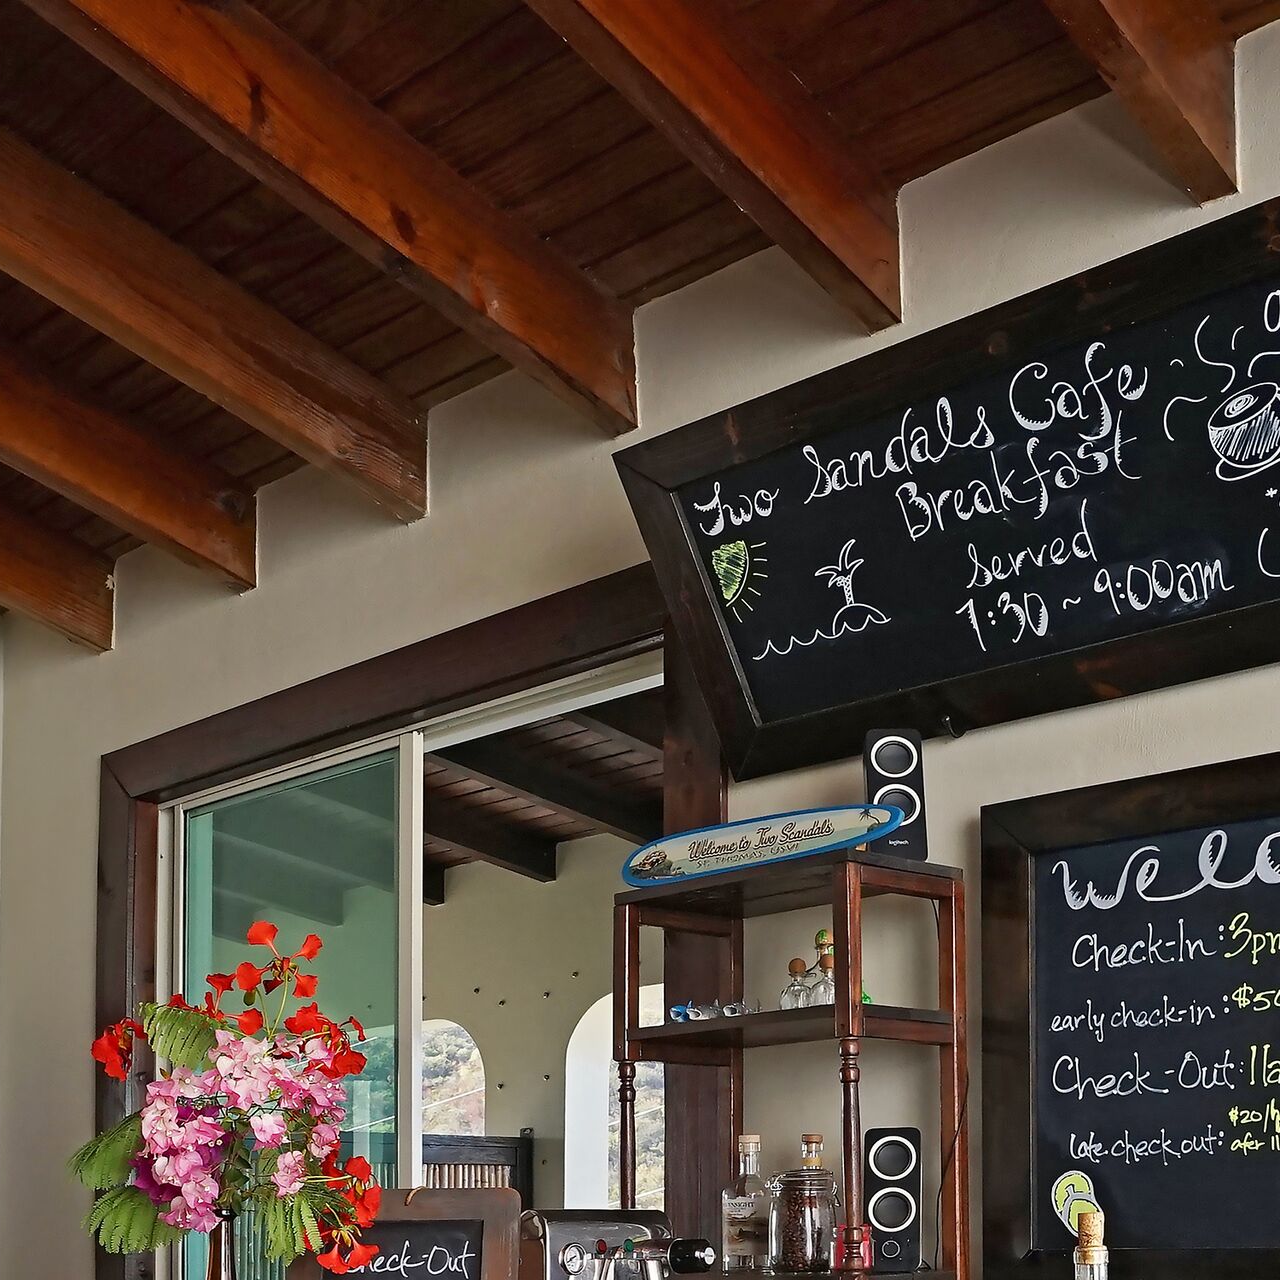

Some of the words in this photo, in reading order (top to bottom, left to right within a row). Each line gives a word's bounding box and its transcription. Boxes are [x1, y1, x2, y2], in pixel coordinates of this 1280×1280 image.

[693, 481, 781, 536] Two
[803, 396, 996, 505] Sandals
[1009, 341, 1148, 441] Cafe
[895, 409, 1142, 541] Breakfast
[966, 498, 1099, 588] Served
[688, 838, 739, 862] Welcome
[737, 835, 752, 853] to
[753, 826, 780, 851] Two
[1051, 999, 1104, 1042] early
[1070, 1131, 1109, 1163] late
[1110, 1127, 1181, 1166] check
